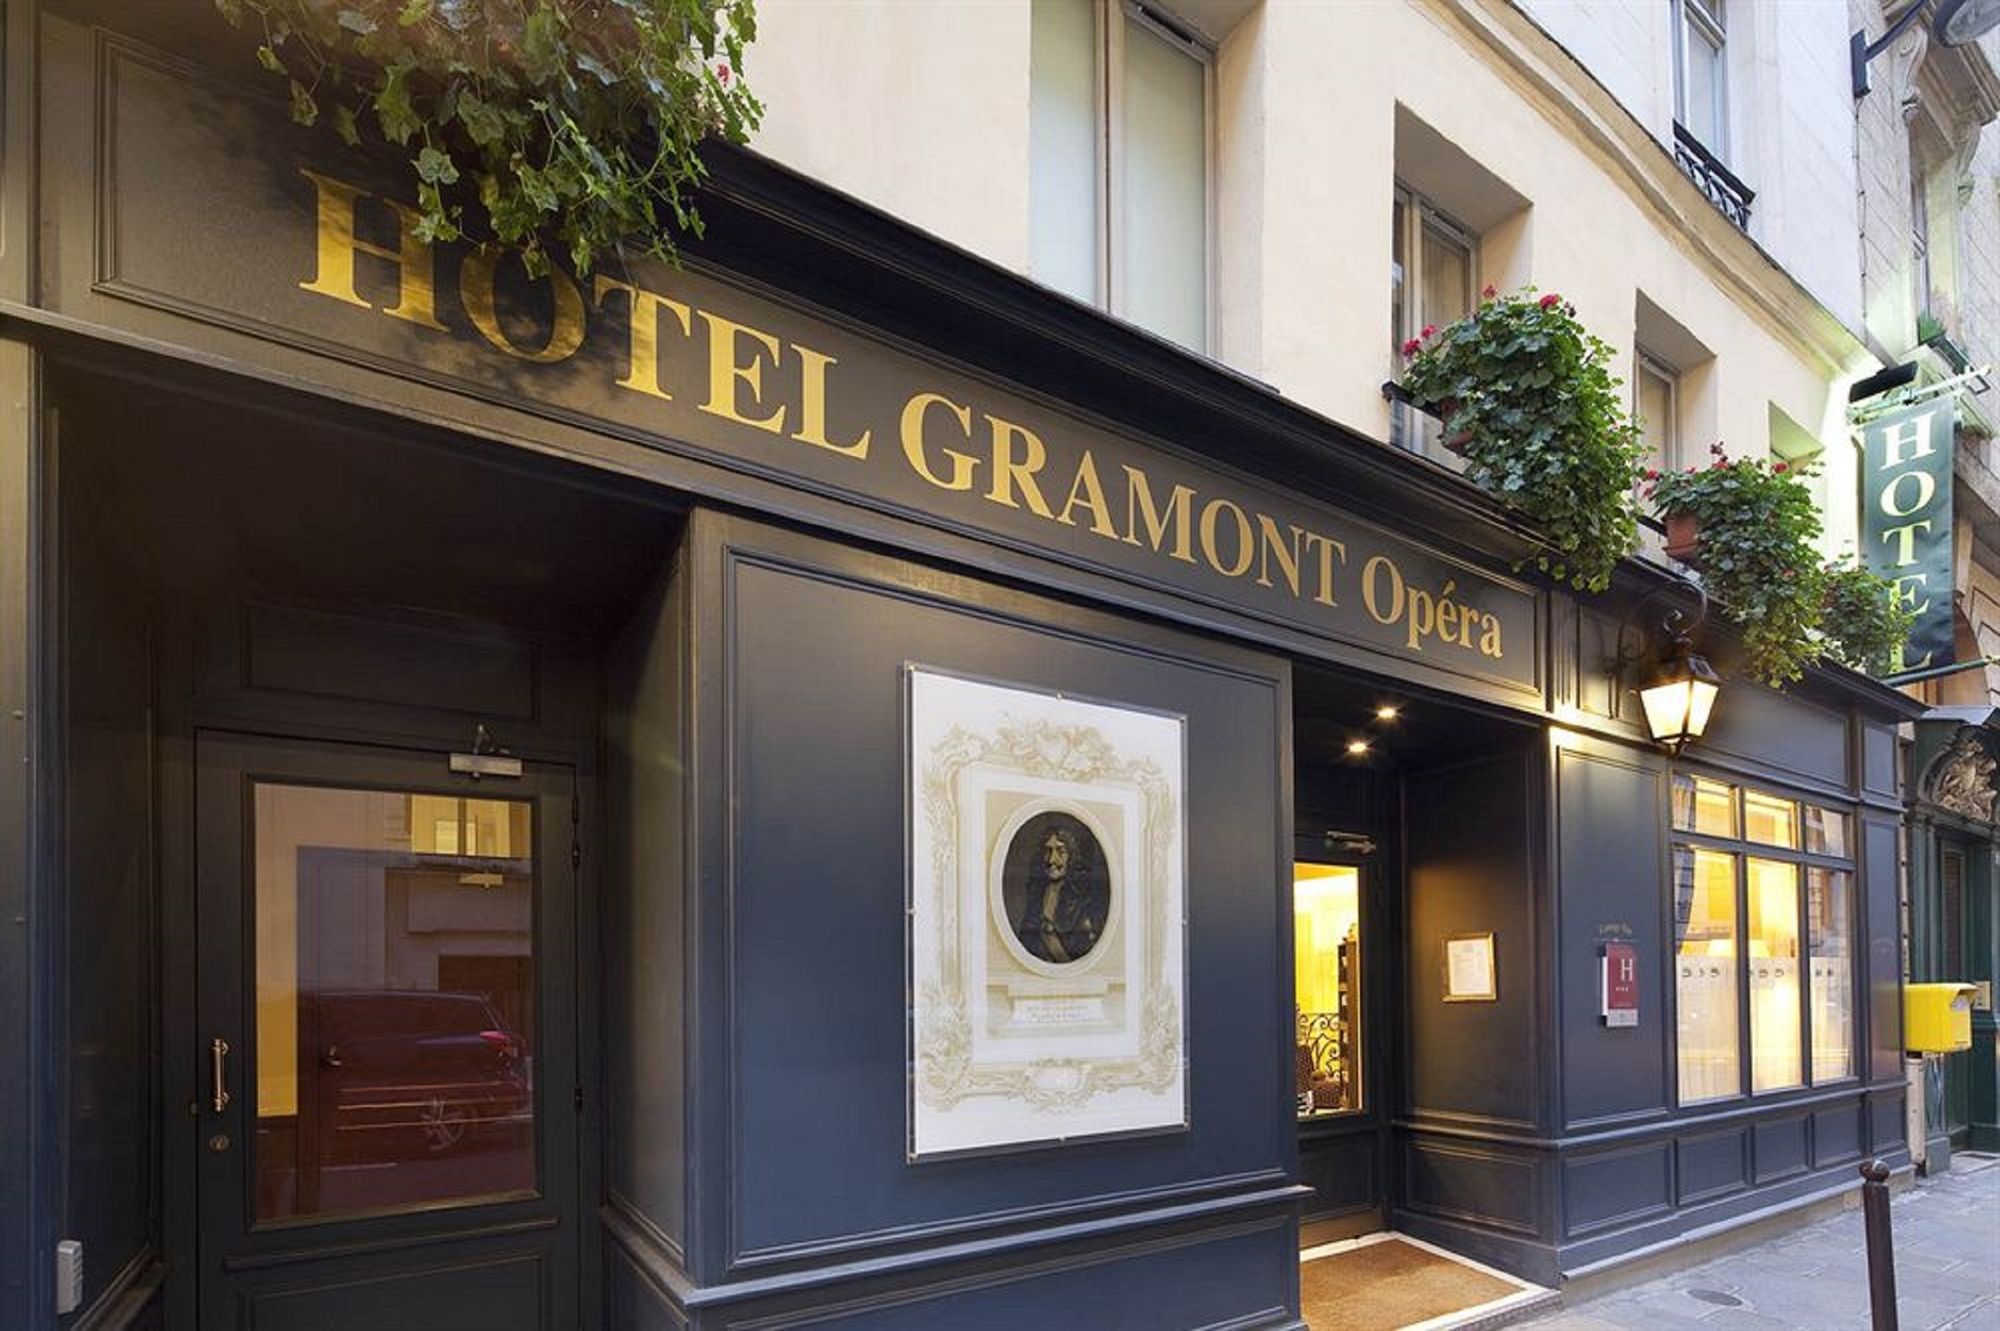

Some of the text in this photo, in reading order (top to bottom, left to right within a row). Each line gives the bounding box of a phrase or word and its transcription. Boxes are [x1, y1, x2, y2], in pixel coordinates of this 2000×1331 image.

[299, 169, 1504, 659] HOTEL GRAMONT Opéra
[1621, 958, 1633, 981] H
